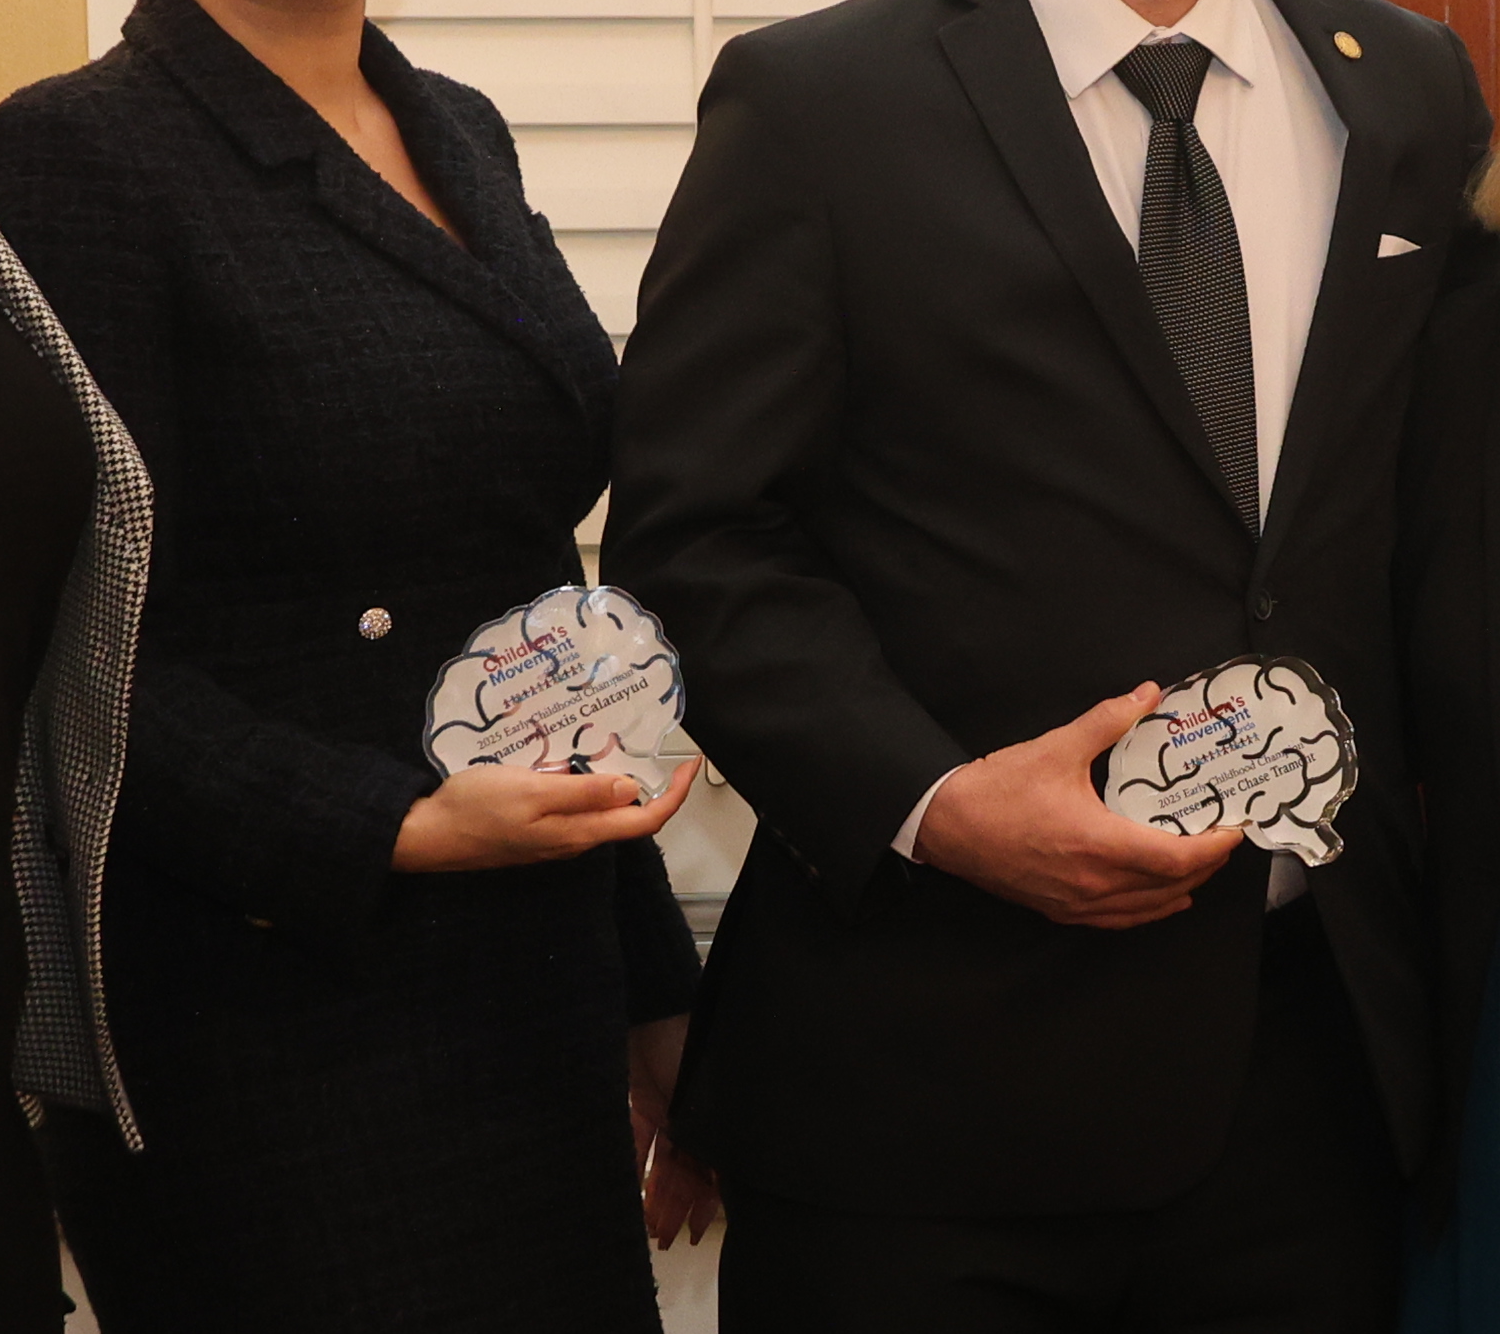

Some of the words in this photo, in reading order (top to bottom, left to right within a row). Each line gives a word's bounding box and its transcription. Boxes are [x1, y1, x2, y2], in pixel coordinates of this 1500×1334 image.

[489, 637, 575, 686] Movement
[477, 733, 503, 750] 2025
[503, 718, 531, 737] Early
[531, 693, 582, 724] Childhood
[583, 669, 636, 697] Champion
[579, 676, 649, 718] Calatayud
[1172, 708, 1252, 748] Movement
[1158, 792, 1181, 809] 2025
[1183, 782, 1207, 798] Early
[1208, 759, 1256, 786] Childhood
[1237, 772, 1270, 793] Chase
